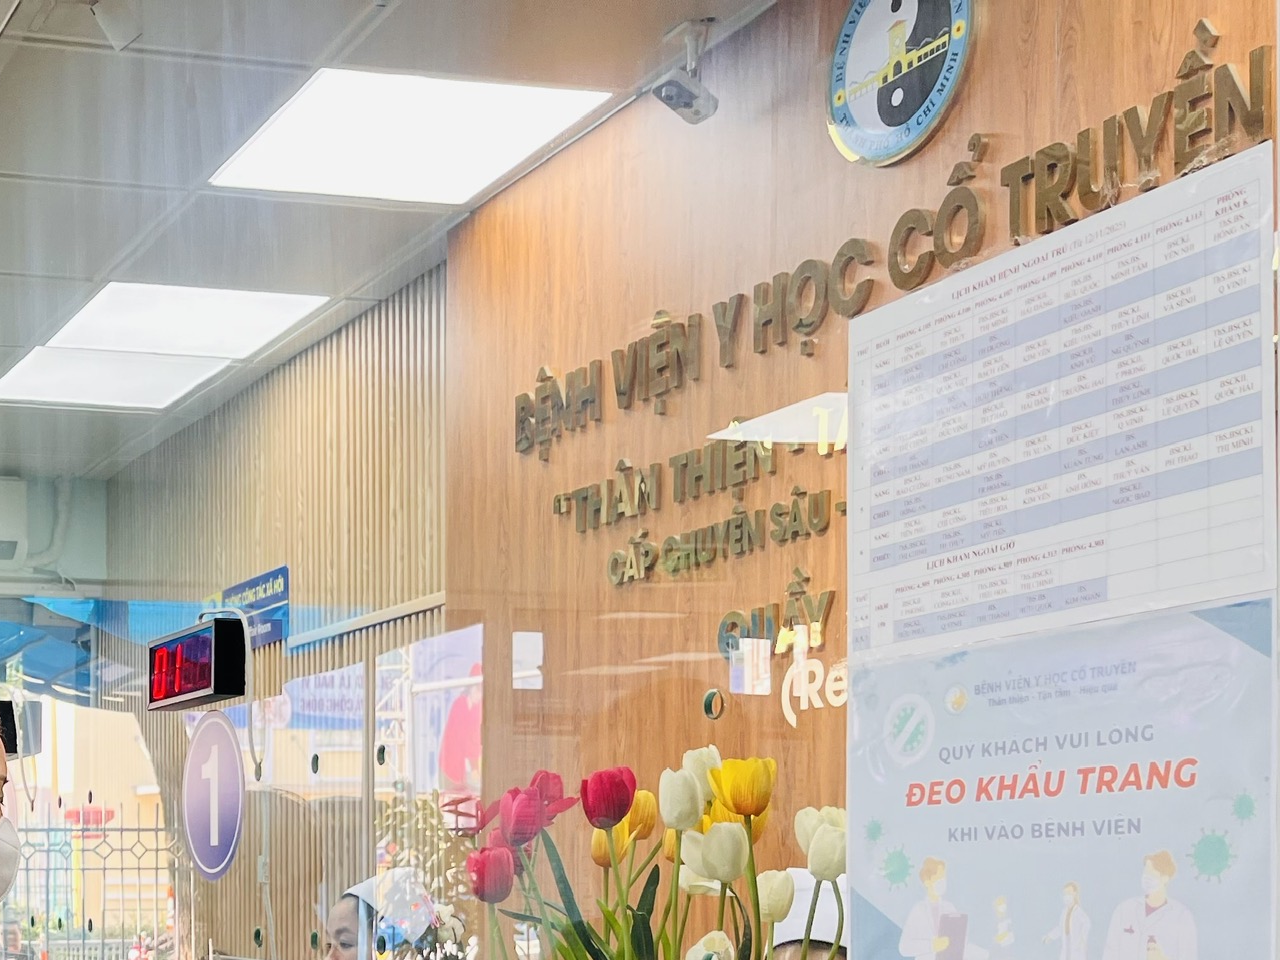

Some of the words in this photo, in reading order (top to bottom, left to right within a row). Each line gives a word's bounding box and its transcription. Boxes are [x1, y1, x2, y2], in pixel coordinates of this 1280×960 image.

[937, 52, 958, 97] MINH
[515, 360, 601, 462] BỆNH
[611, 309, 702, 415] VIỆN
[712, 293, 746, 369] Y
[753, 237, 874, 357] HỌC
[887, 132, 986, 293] CỔ
[1000, 17, 1271, 246] TRUYỀN
[608, 528, 660, 586] CẤP
[661, 506, 766, 577] CHUYÊN
[770, 486, 832, 543] SÂU
[717, 566, 836, 662] QUẦY
[153, 643, 183, 700] 01
[974, 680, 1001, 699] BỆNH
[1034, 675, 1041, 687] Y
[1044, 671, 1068, 688] HỌC
[981, 731, 1048, 759] KHÁCH
[1054, 731, 1089, 750] VUI
[1096, 723, 1155, 747] LÒNG
[200, 744, 219, 847] 1
[905, 777, 966, 807] ĐEO
[974, 759, 1066, 803] KHẨU
[1076, 757, 1199, 794] TRANG
[948, 826, 978, 842] KHI
[983, 820, 1024, 841] VÀO
[1030, 817, 1085, 843] BỆNH
[1091, 812, 1142, 840] VIỆN
